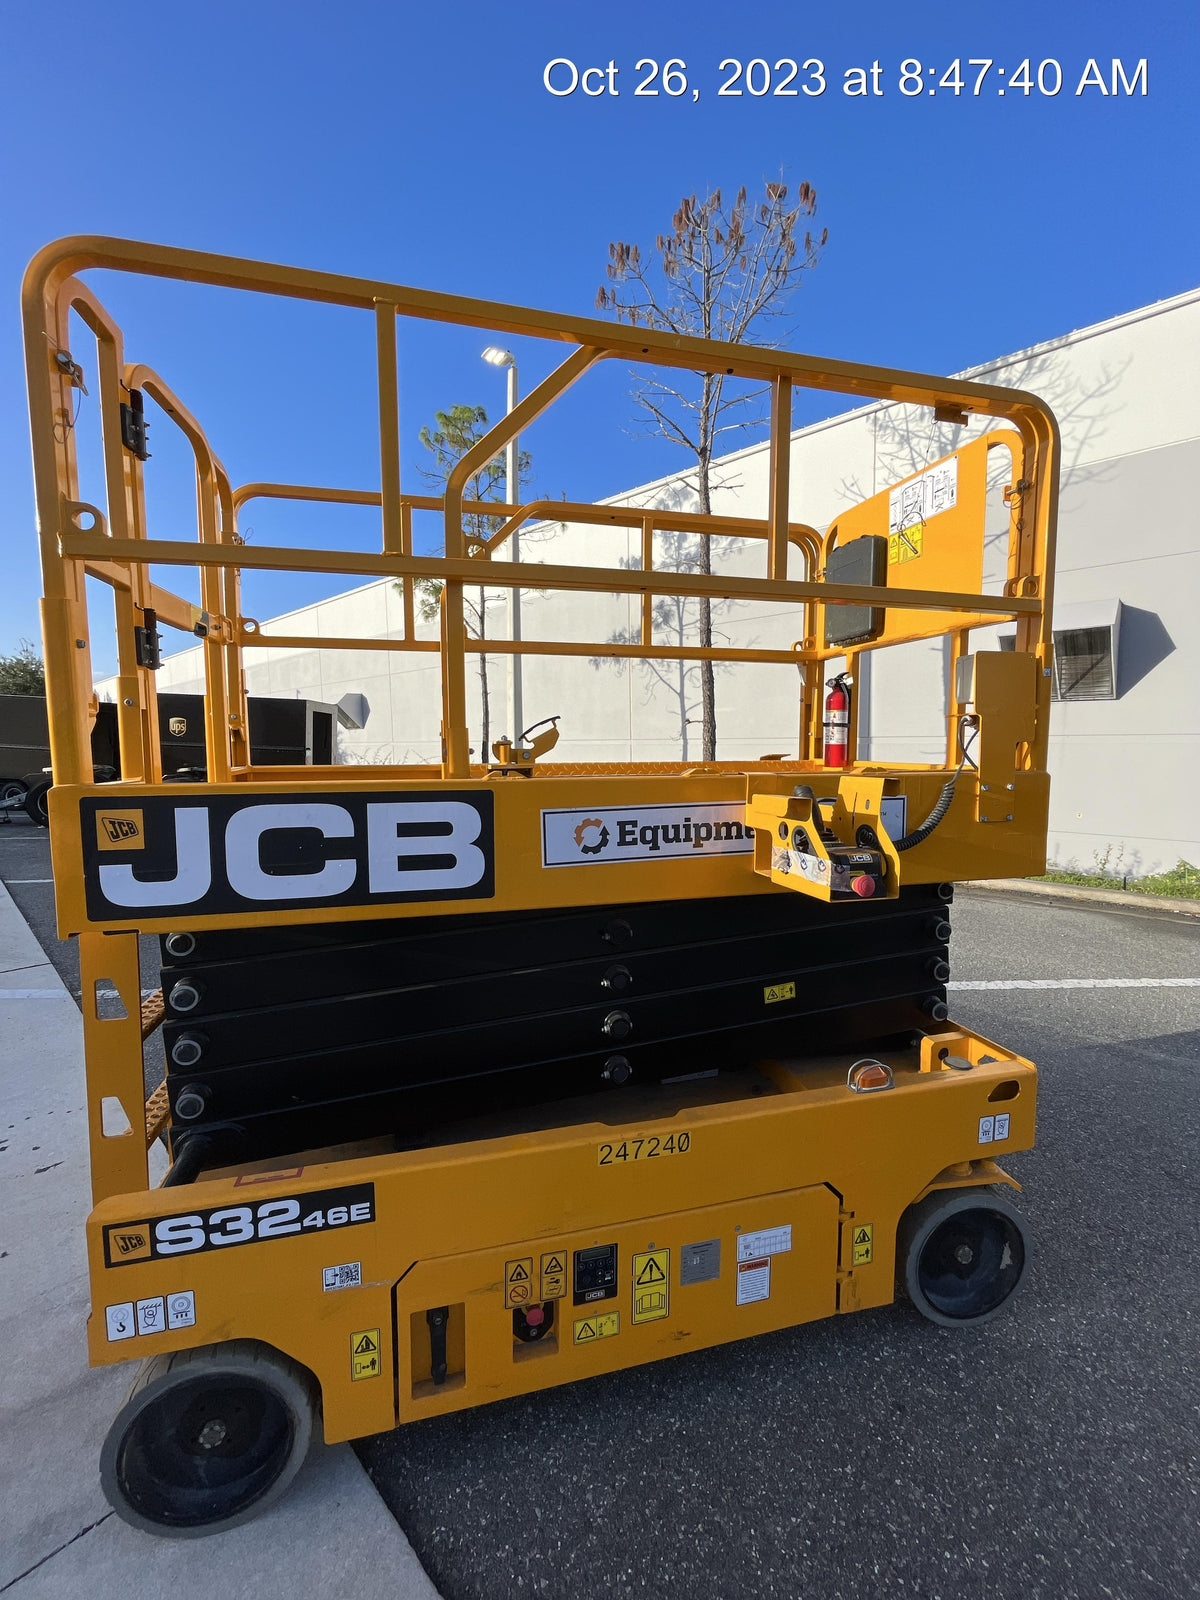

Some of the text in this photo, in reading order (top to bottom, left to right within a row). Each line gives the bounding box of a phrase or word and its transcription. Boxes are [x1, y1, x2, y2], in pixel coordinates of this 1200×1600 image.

[108, 820, 136, 840] JCB
[99, 801, 486, 908] JCB
[599, 1131, 690, 1166] 247240
[120, 1235, 144, 1253] JCB
